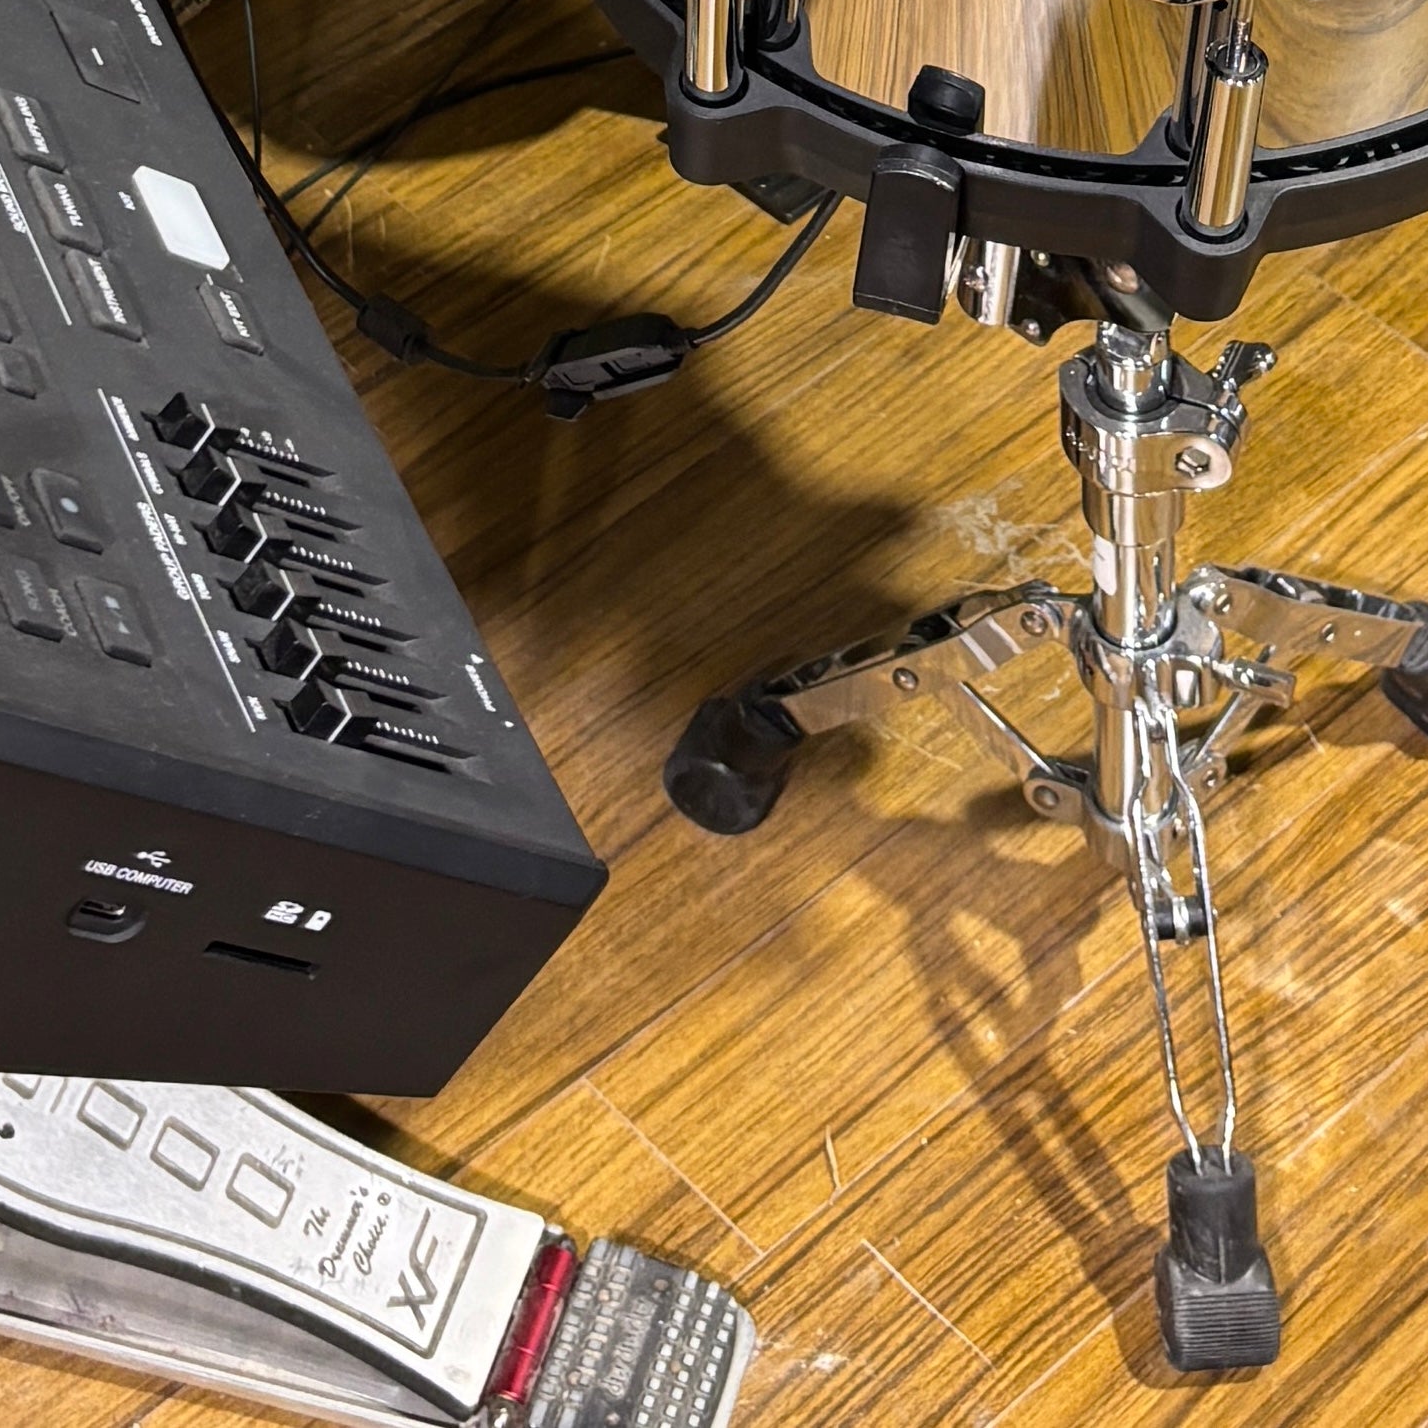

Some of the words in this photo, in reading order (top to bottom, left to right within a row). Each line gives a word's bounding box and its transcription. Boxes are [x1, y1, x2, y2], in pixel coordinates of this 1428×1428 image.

[13, 95, 50, 154] MUFFLING
[54, 182, 84, 227] TUNING
[87, 257, 128, 324] INSTRUMENT
[137, 501, 169, 553] FADERS
[161, 552, 191, 600] GROUP
[83, 859, 117, 877] USB
[115, 866, 195, 895] COMPUTER
[302, 1206, 331, 1240] The
